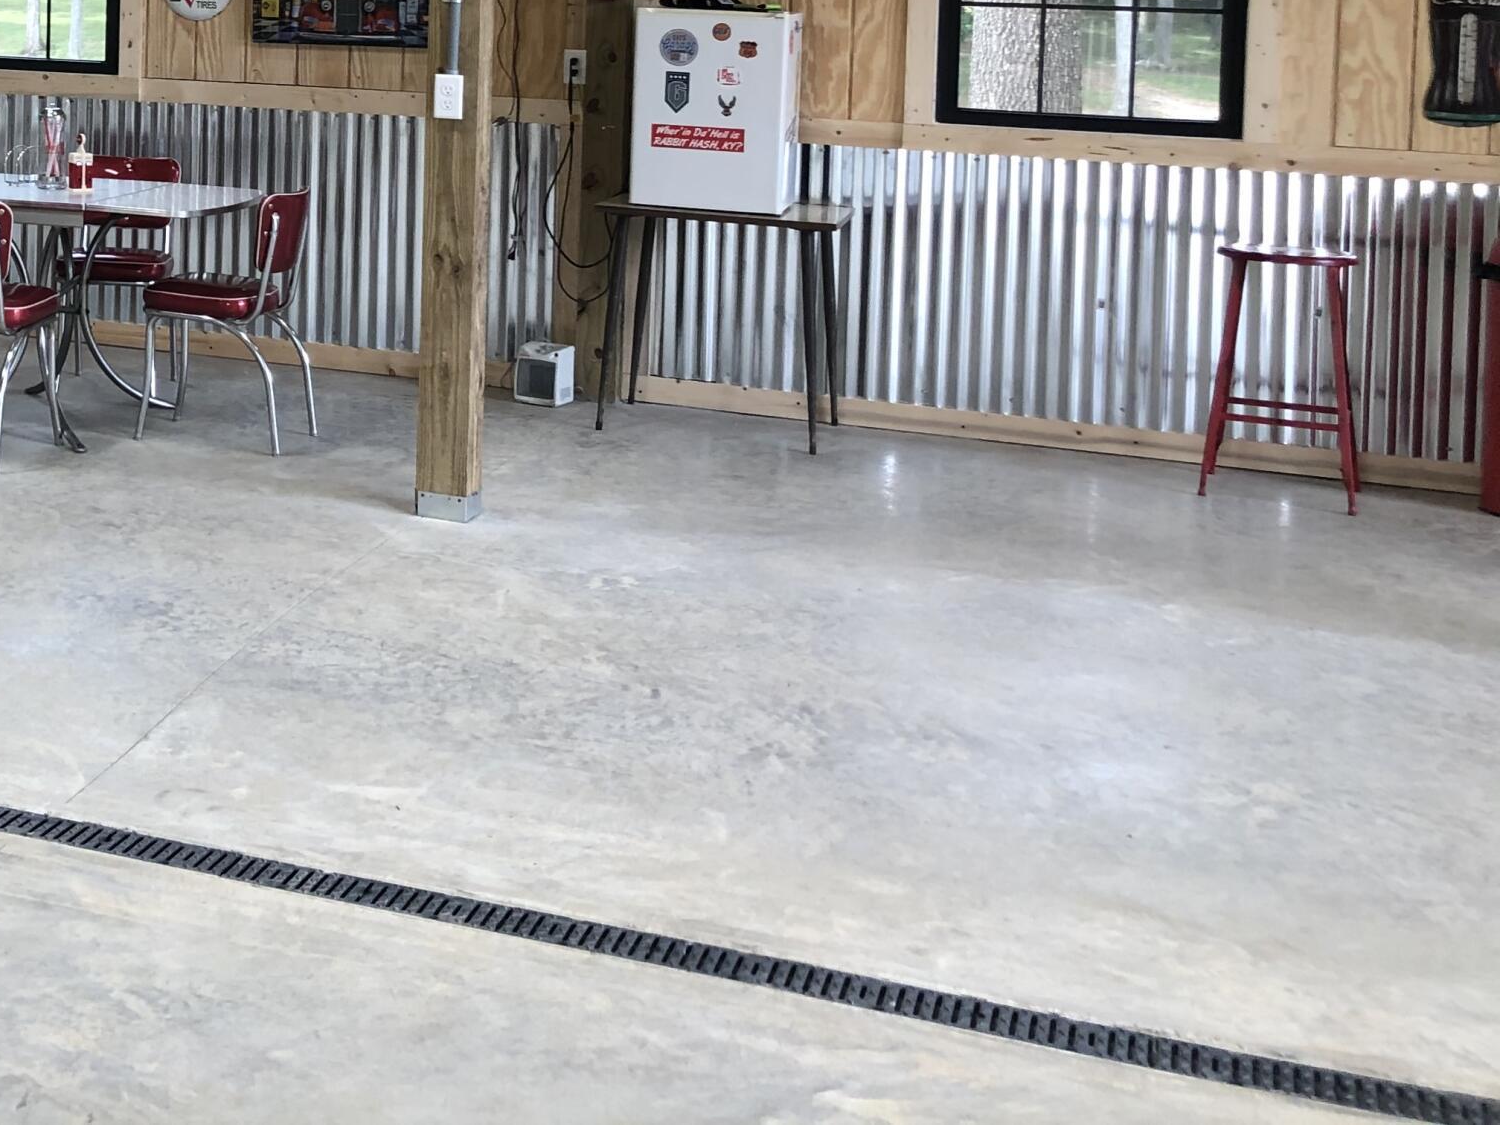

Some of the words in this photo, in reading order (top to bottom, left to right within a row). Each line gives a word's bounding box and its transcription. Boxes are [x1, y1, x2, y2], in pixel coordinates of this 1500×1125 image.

[196, 0, 218, 10] TIRES
[710, 129, 730, 139] Hell
[729, 130, 741, 139] is
[653, 136, 689, 147] RABBIT
[721, 141, 744, 151] KY?
